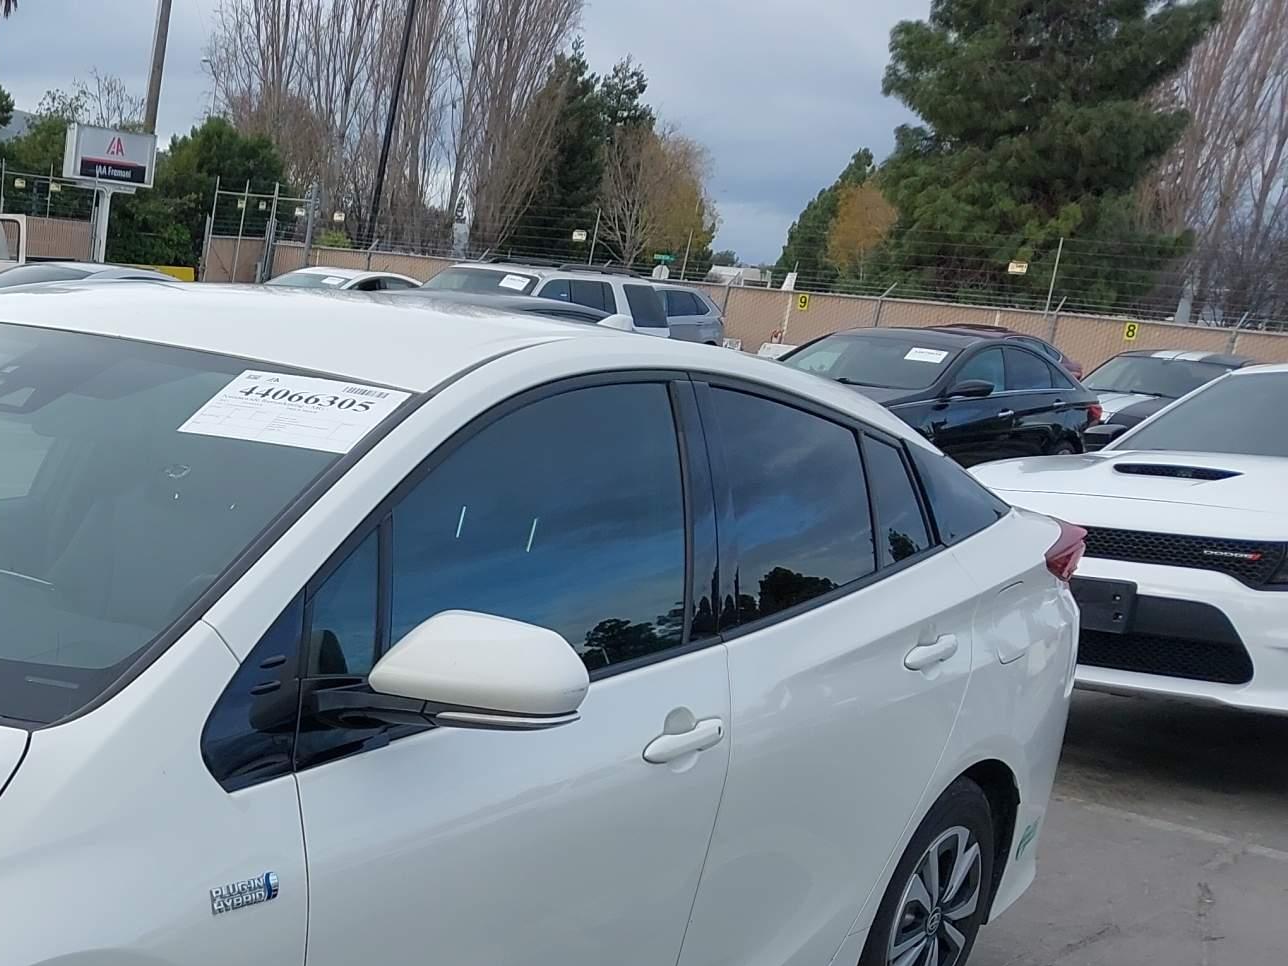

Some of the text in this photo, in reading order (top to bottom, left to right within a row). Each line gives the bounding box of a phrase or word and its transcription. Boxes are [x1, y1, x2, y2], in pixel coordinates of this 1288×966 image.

[799, 295, 807, 308] 9
[1126, 324, 1136, 338] 8
[239, 385, 376, 413] 44066305
[1203, 550, 1253, 559] DODGE
[212, 877, 264, 898] PLUG-IN
[213, 891, 265, 910] HYBRID
